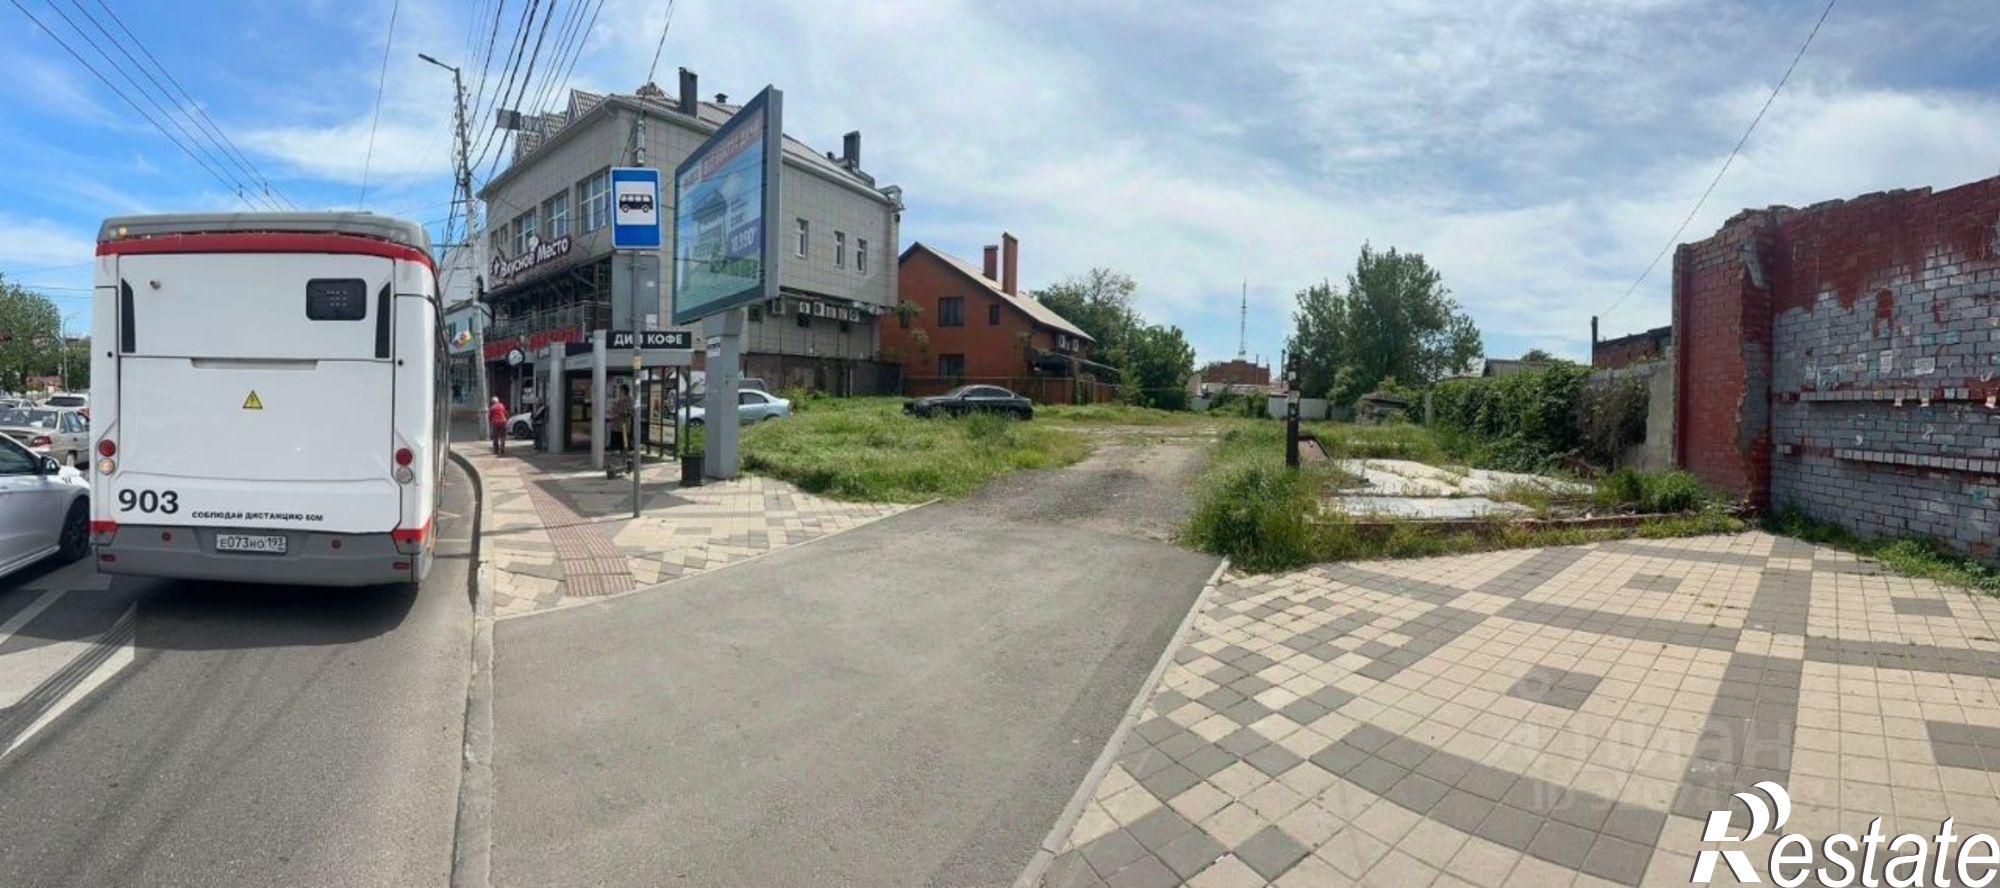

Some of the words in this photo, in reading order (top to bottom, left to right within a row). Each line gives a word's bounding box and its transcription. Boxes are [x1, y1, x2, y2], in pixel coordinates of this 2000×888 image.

[537, 238, 569, 264] Место
[613, 333, 643, 346] ДИ
[647, 333, 683, 345] КОФЕ
[118, 488, 179, 514] 903
[244, 511, 304, 521] ДИСТАНЦИЮ
